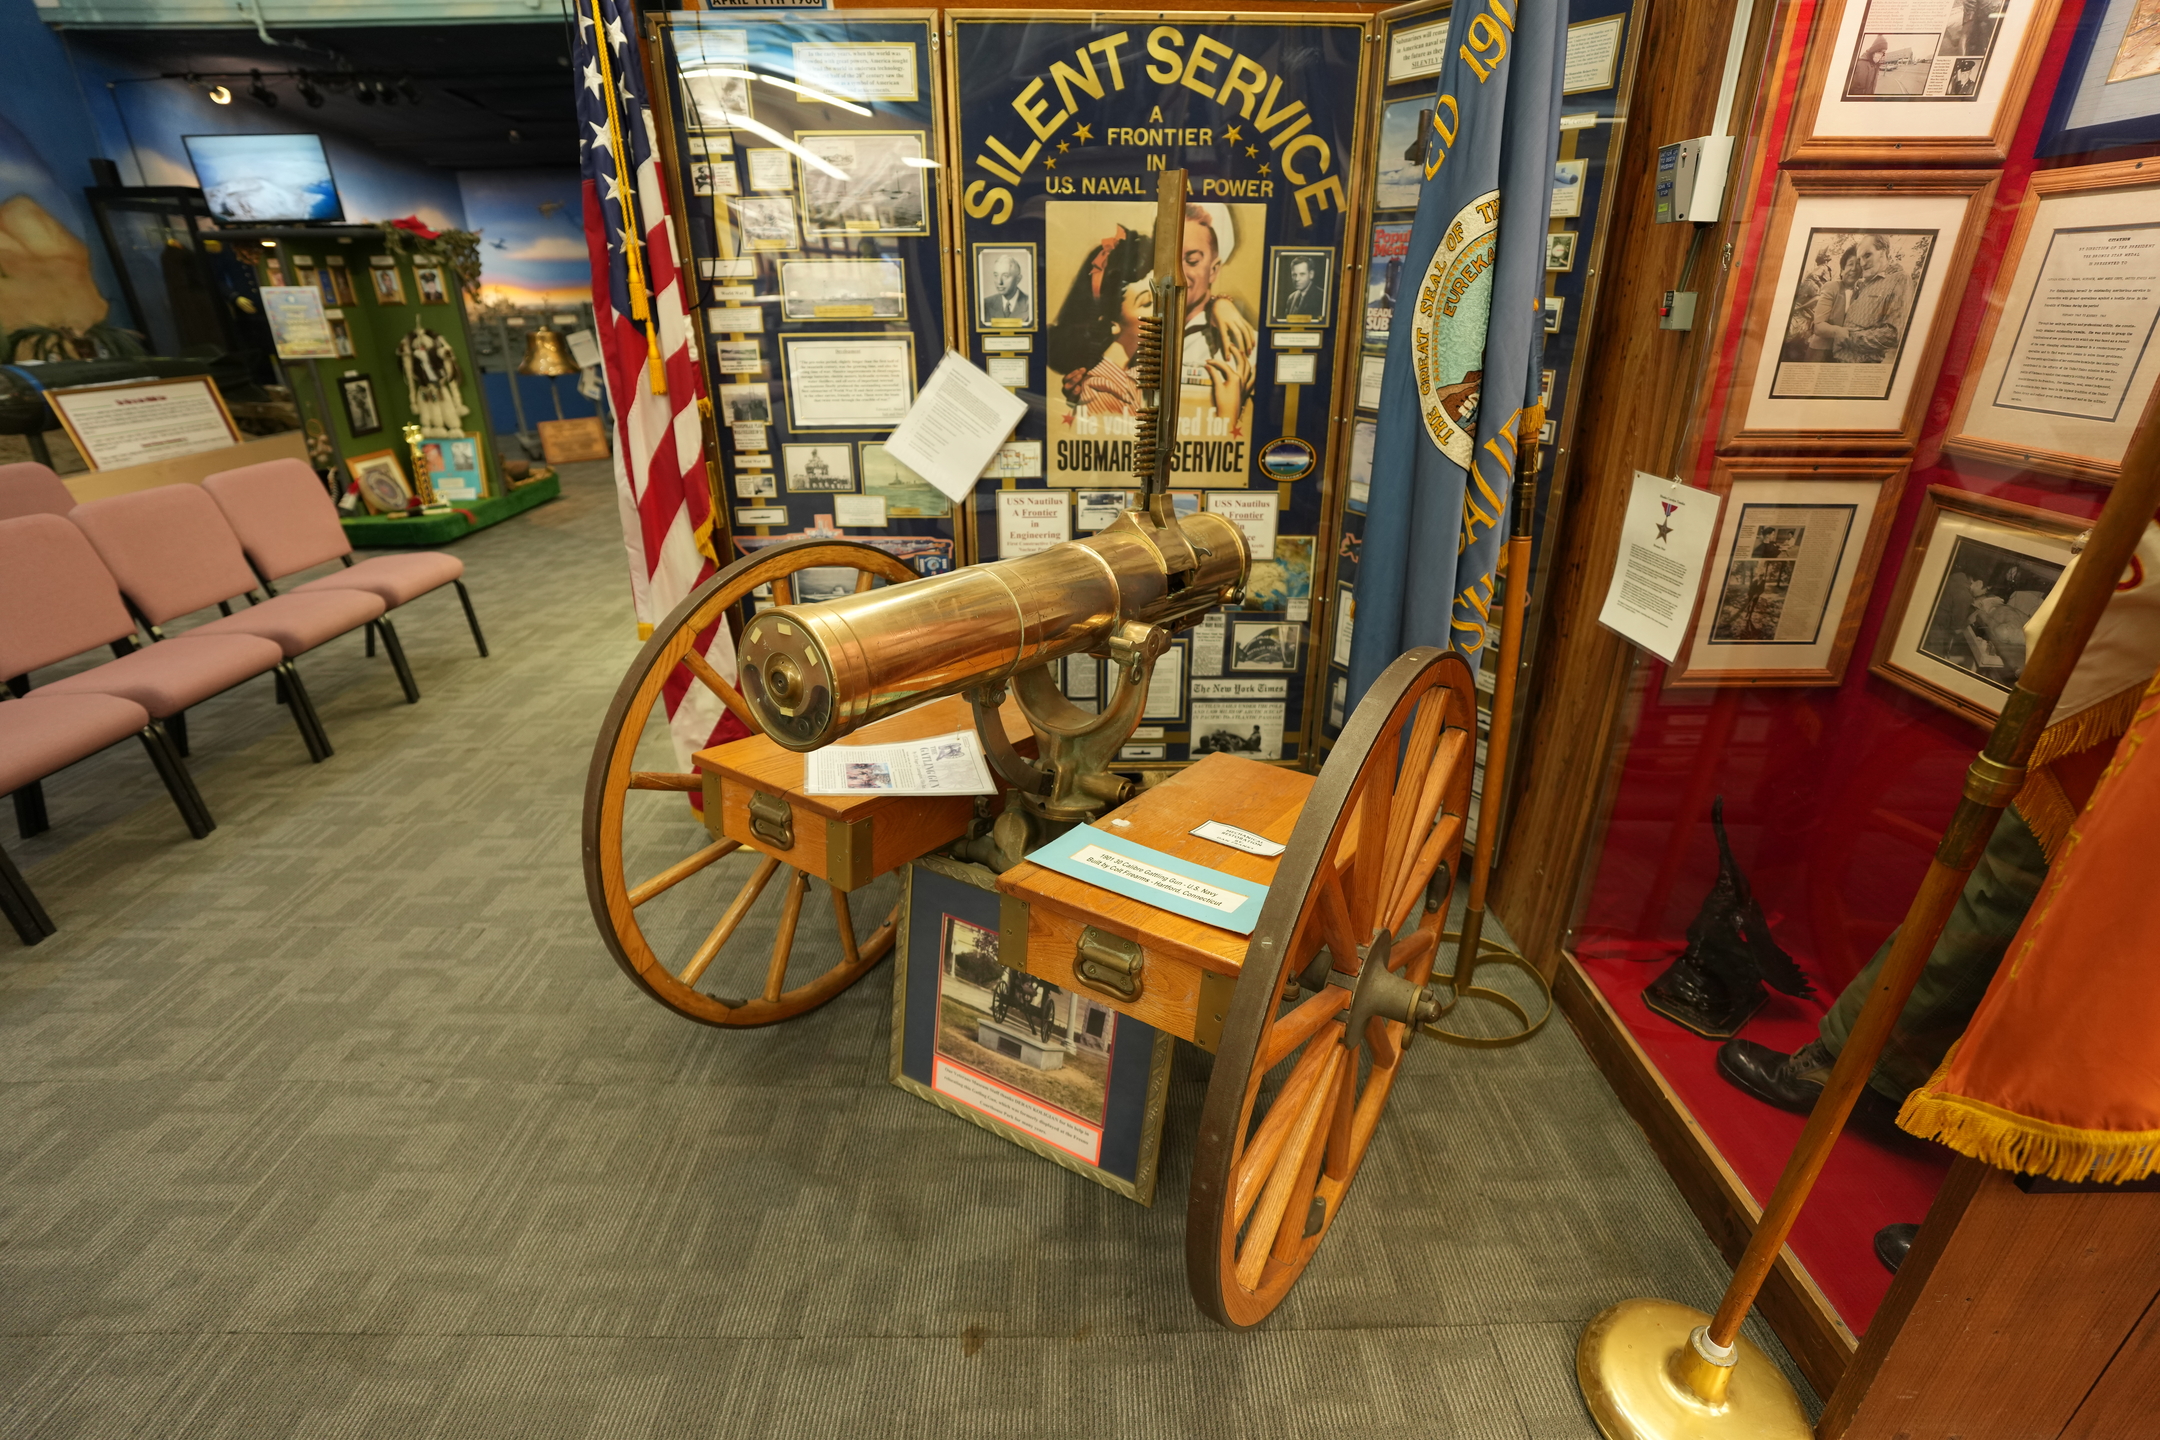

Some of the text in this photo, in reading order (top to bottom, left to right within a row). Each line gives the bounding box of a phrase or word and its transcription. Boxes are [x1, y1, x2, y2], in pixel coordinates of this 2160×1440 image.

[1433, 28, 1448, 36] remai
[1402, 39, 1439, 52] American naval
[1412, 58, 1439, 68] SILENTLY
[1149, 106, 1163, 122] A
[964, 26, 1348, 228] SILENT SERVICE
[1107, 128, 1212, 146] FRONTIER
[1146, 154, 1166, 171] IN
[1045, 176, 1076, 194] U.S.
[1082, 177, 1146, 195] NAVAL
[1202, 178, 1274, 198] POWER
[1446, 221, 1464, 252] OF
[1420, 260, 1448, 318] SEAL
[1416, 328, 1431, 395] GREAT
[1076, 405, 1098, 436] He
[1206, 406, 1230, 436] for
[1426, 406, 1455, 446] THE
[1170, 441, 1244, 472] SERVICE
[1007, 497, 1063, 506] USS Nautilus
[1214, 500, 1270, 508] USS Nautilus
[1022, 508, 1058, 518] Frontier
[1229, 511, 1264, 520] Frontier
[1010, 531, 1061, 540] Engineering
[1193, 683, 1211, 694] The
[1212, 684, 1232, 694] New
[1234, 683, 1255, 695] York
[1222, 832, 1262, 846] RESTORATION
[1086, 857, 1102, 866] Built
[1123, 870, 1150, 882] Firearms
[1183, 890, 1222, 906] Connecticut
[1122, 862, 1144, 872] Calibre
[1201, 889, 1218, 897] Navy
[998, 1100, 1010, 1109] which
[1019, 1110, 1038, 1122] formerly
[1039, 1119, 1059, 1132] displayed
[1072, 1134, 1088, 1144] Fresno
[1073, 1126, 1084, 1134] help
